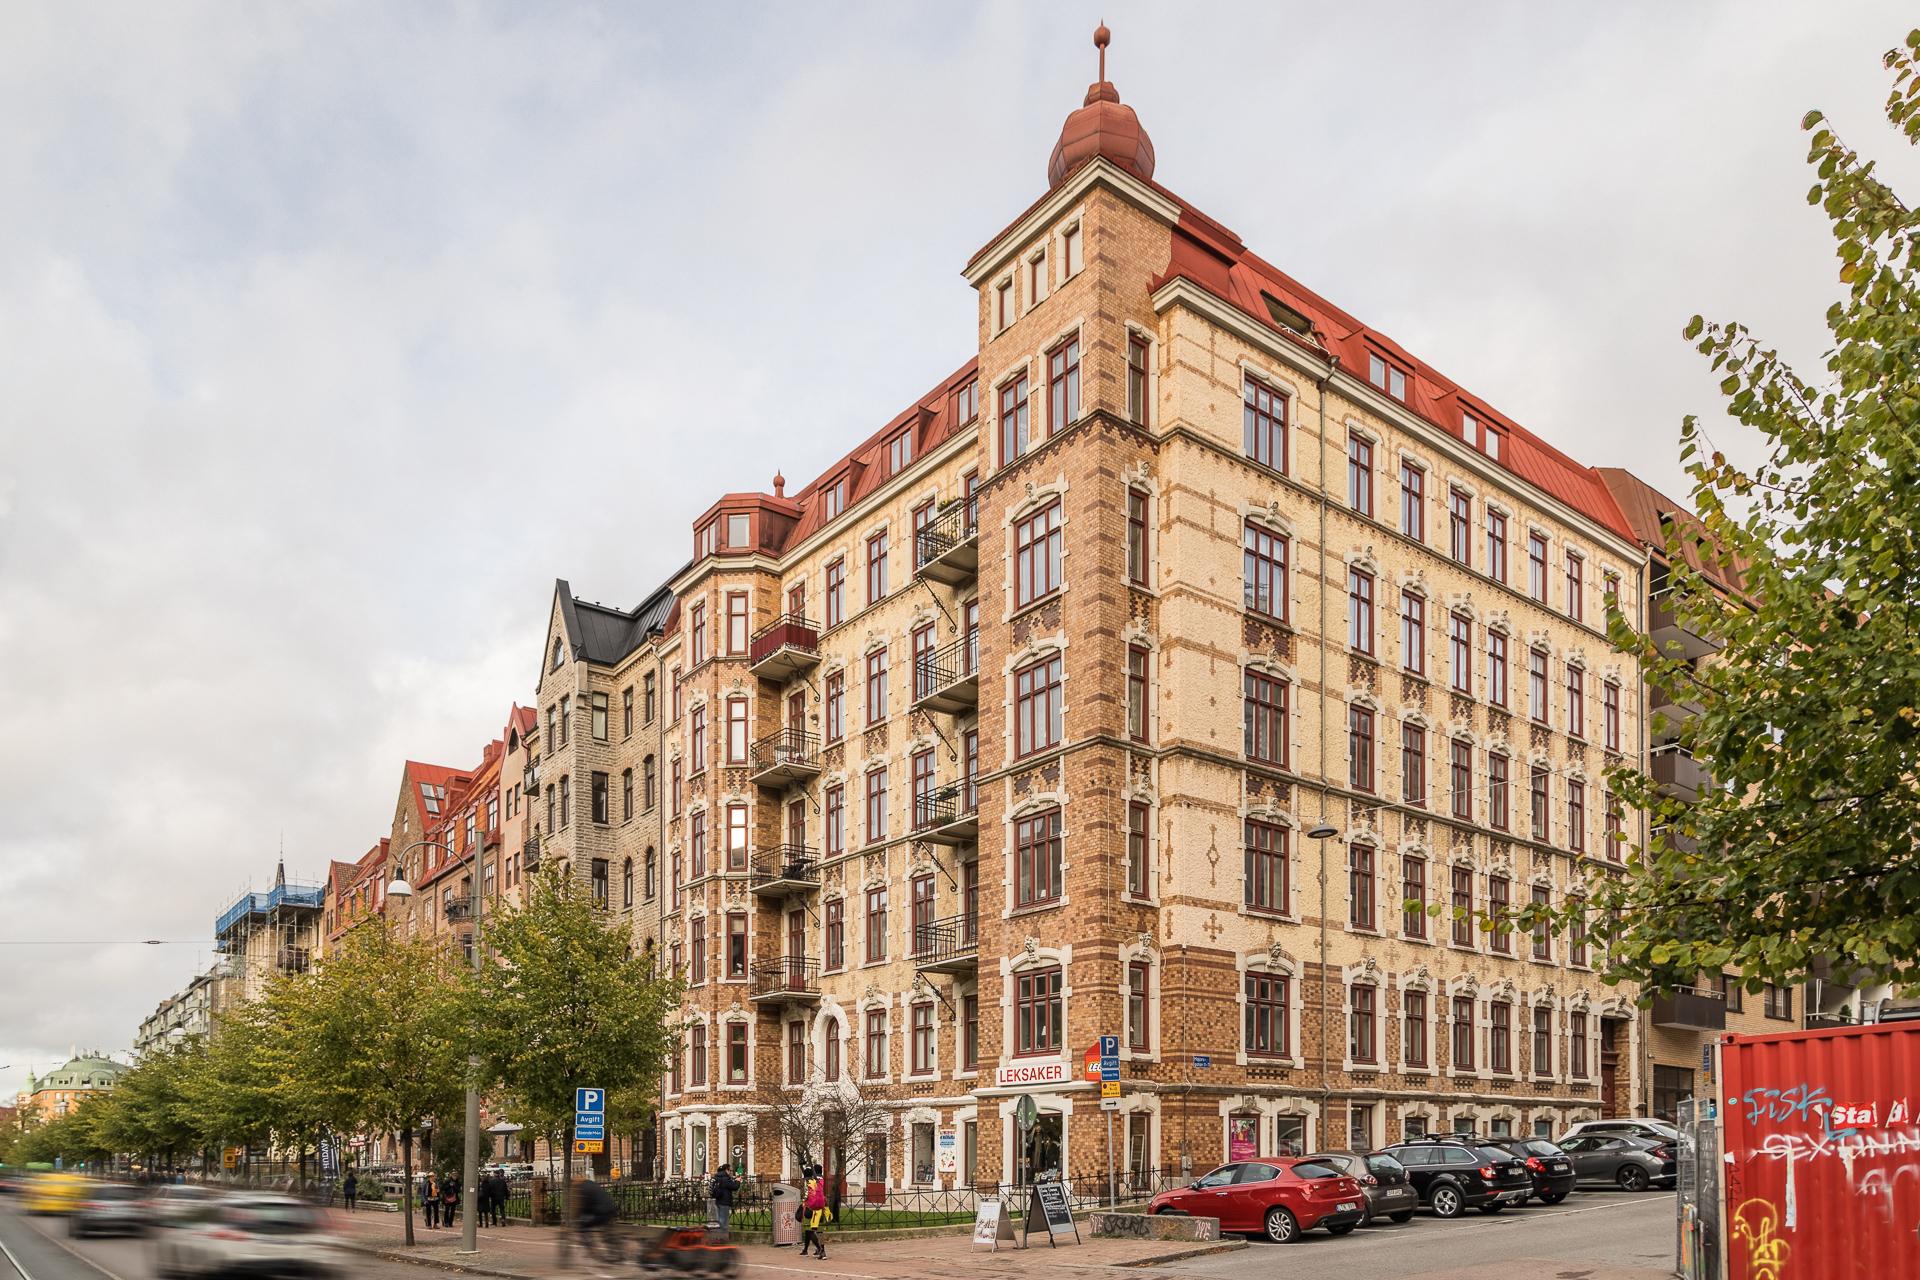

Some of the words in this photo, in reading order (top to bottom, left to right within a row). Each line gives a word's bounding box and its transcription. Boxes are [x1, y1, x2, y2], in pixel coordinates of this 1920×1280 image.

[1105, 1038, 1115, 1055] P
[1000, 1065, 1062, 1083] LEKSAKER
[585, 1091, 598, 1110] P
